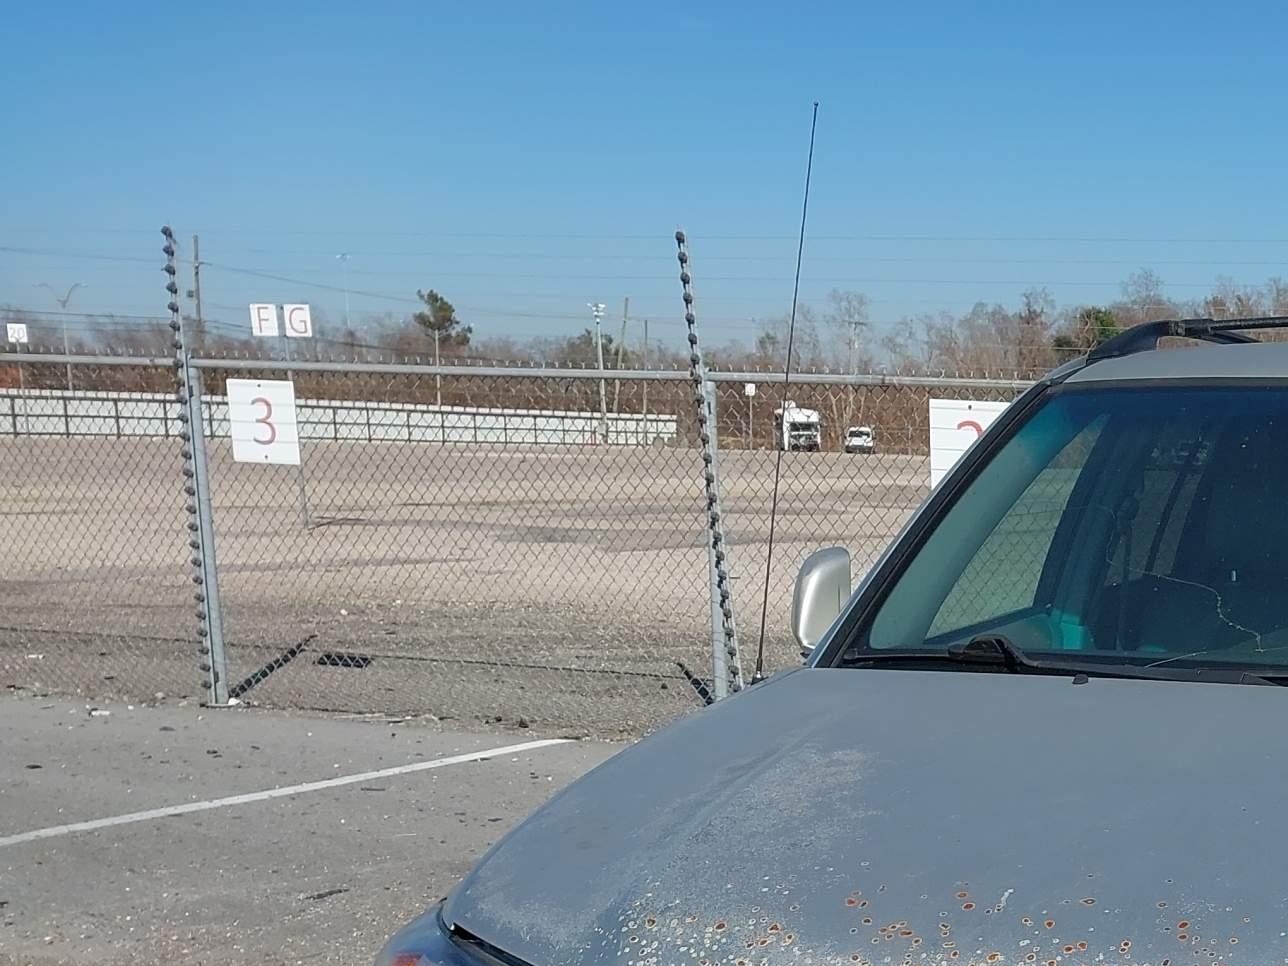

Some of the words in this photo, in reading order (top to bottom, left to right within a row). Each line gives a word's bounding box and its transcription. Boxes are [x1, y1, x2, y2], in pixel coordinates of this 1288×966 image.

[256, 306, 270, 333] F
[288, 306, 308, 334] G
[250, 396, 277, 446] 3
